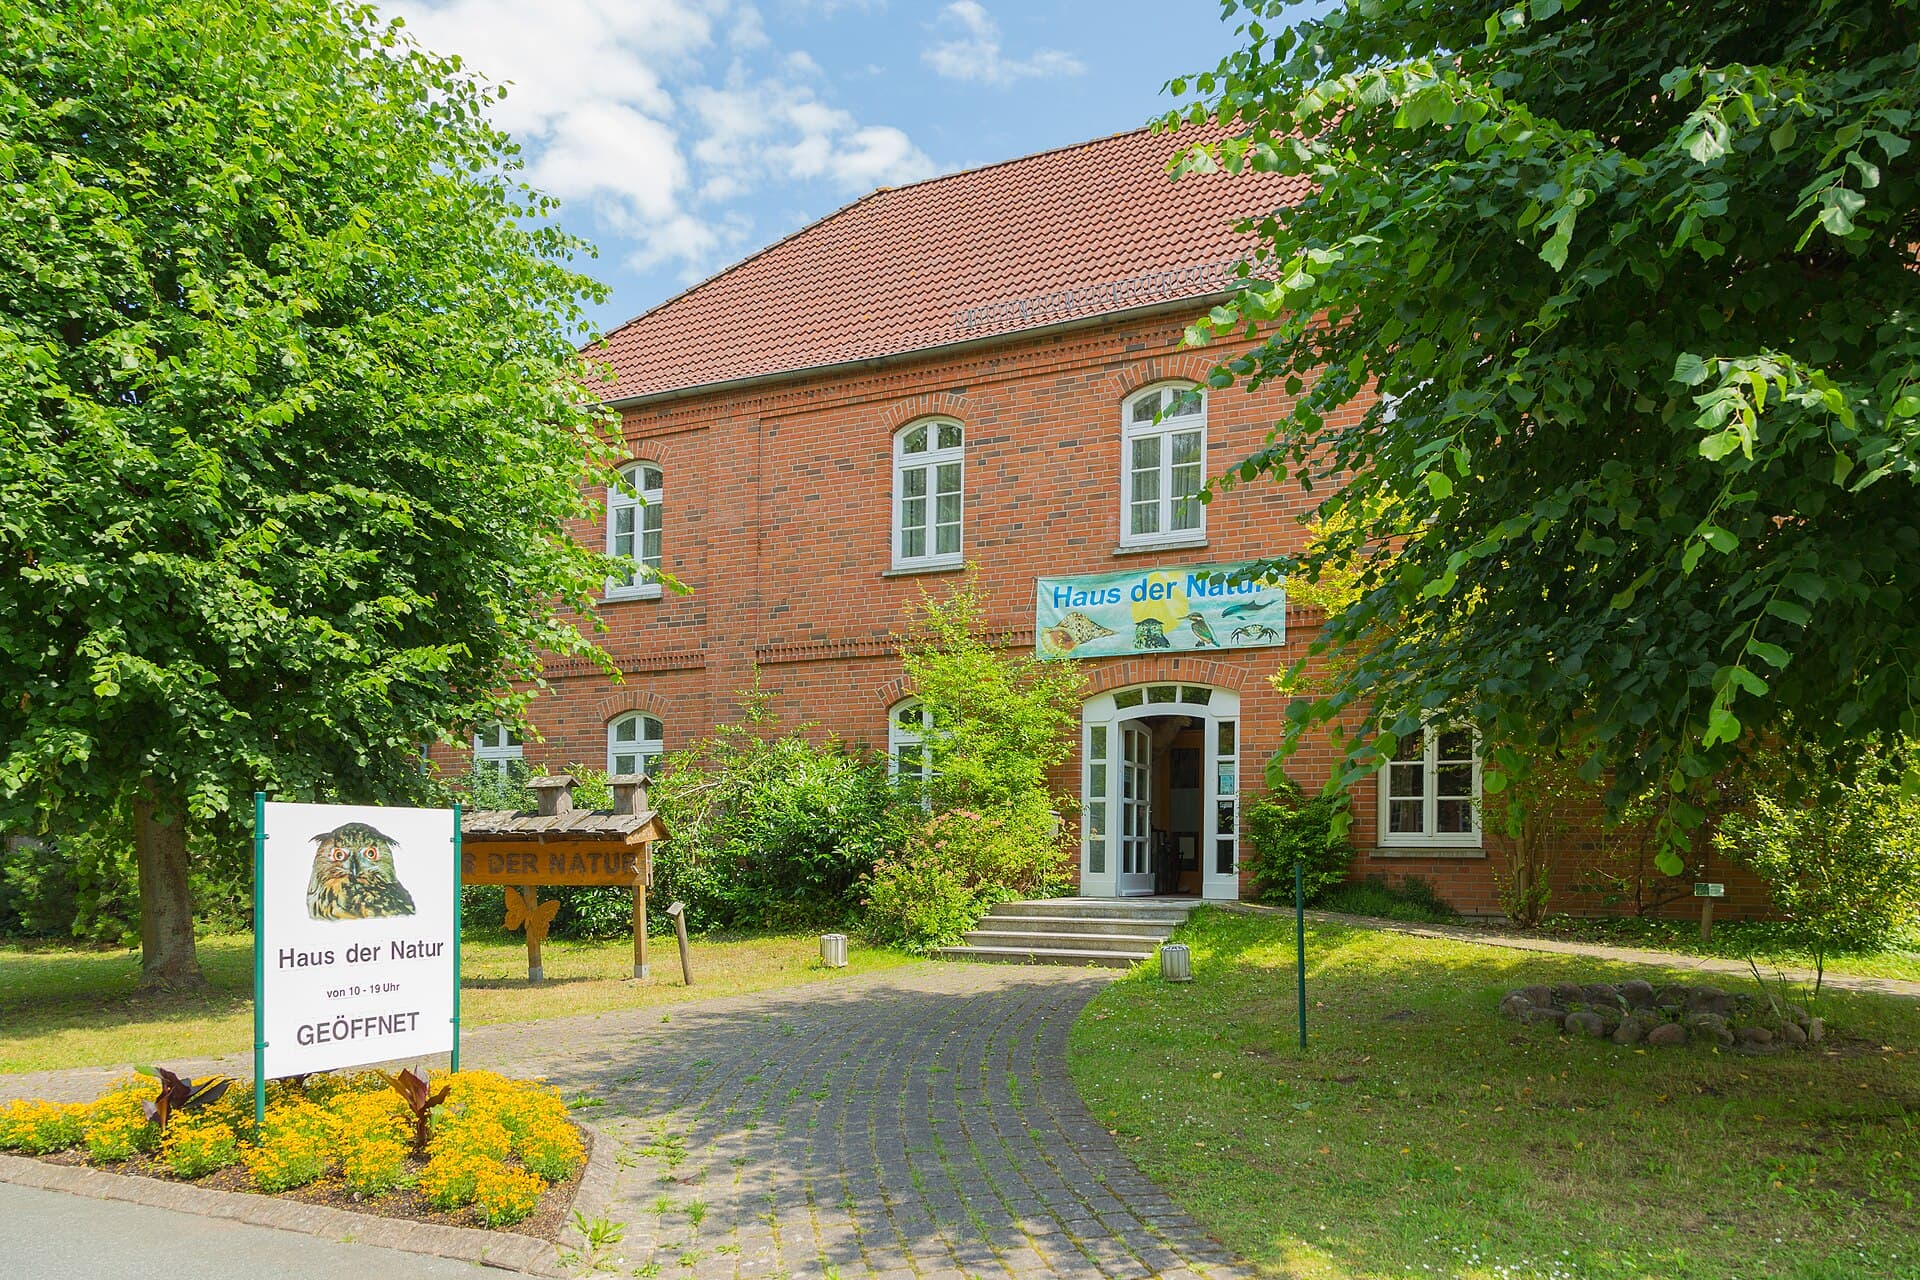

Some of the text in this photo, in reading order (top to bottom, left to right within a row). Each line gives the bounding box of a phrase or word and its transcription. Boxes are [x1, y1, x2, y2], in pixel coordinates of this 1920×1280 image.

[1053, 585, 1121, 609] Haus
[1130, 578, 1178, 602] der
[487, 853, 538, 874] DER
[548, 853, 639, 874] NATUR
[278, 940, 444, 969] Haus der Natur
[326, 989, 346, 998] von
[349, 986, 361, 996] 10
[370, 984, 381, 994] 19
[383, 982, 400, 992] Uhr
[296, 1011, 421, 1046] GEÖFFNET
